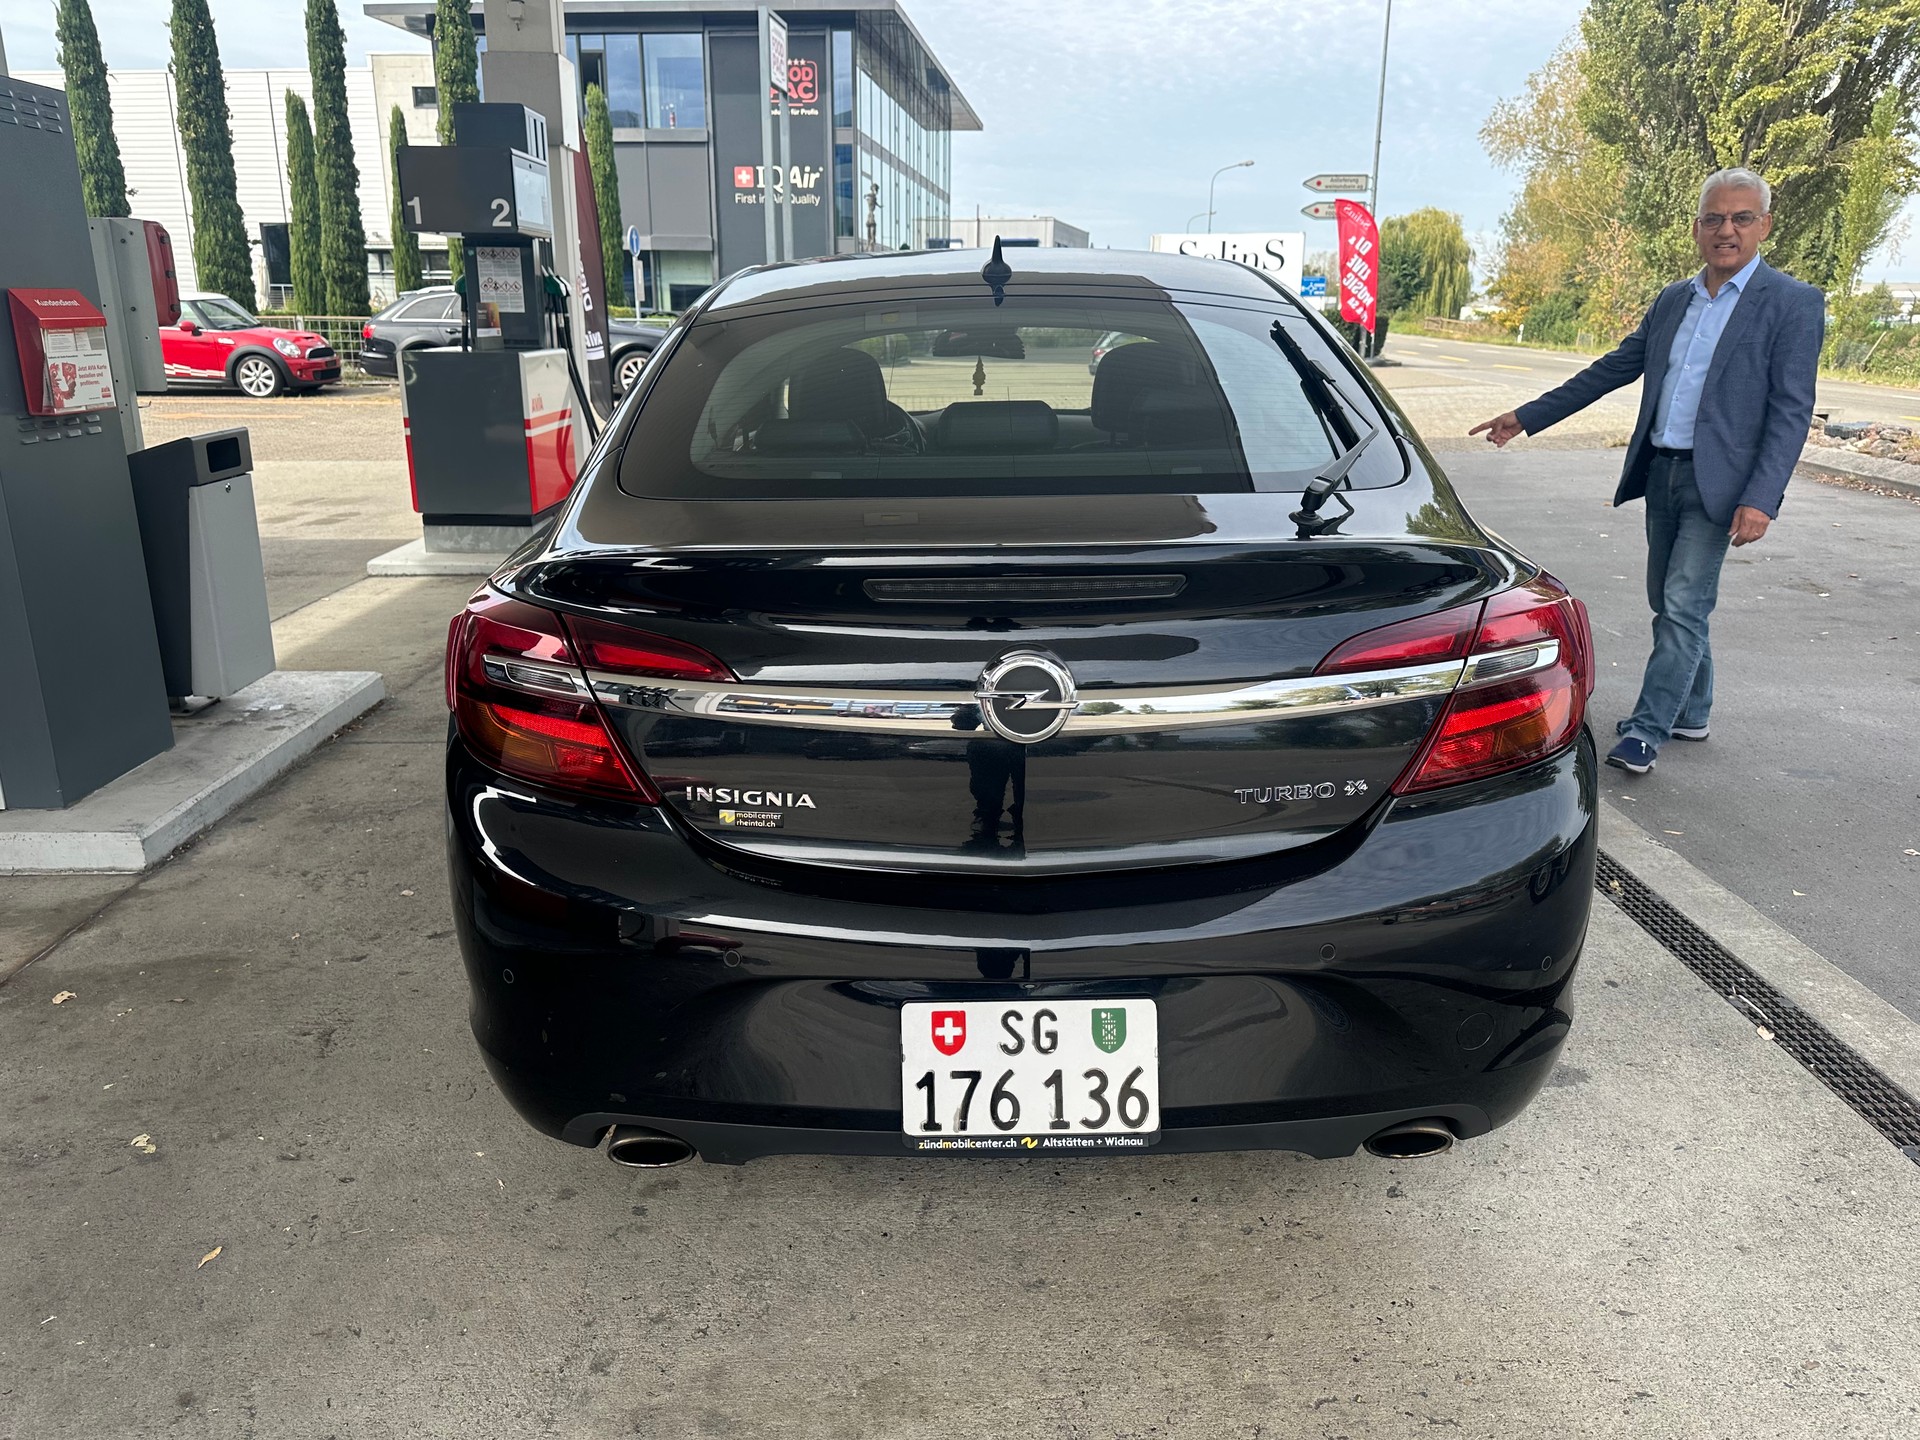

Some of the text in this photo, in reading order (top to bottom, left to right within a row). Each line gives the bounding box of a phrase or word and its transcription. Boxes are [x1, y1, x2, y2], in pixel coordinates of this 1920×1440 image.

[788, 66, 814, 82] OD
[734, 193, 756, 204] First
[406, 196, 512, 228] 1 2
[1179, 239, 1285, 272] SlinS
[34, 298, 80, 306] Kundendienst
[686, 786, 817, 809] INSIGNIA
[1234, 782, 1336, 804] TURBO
[736, 819, 776, 828] rheintal.ch
[998, 1008, 1059, 1056] SG
[915, 1066, 1150, 1132] 176 136
[918, 1137, 1017, 1149] zündmobilcenter.ch
[1042, 1136, 1094, 1148] Altstätten
[1104, 1136, 1144, 1147] Widnau
